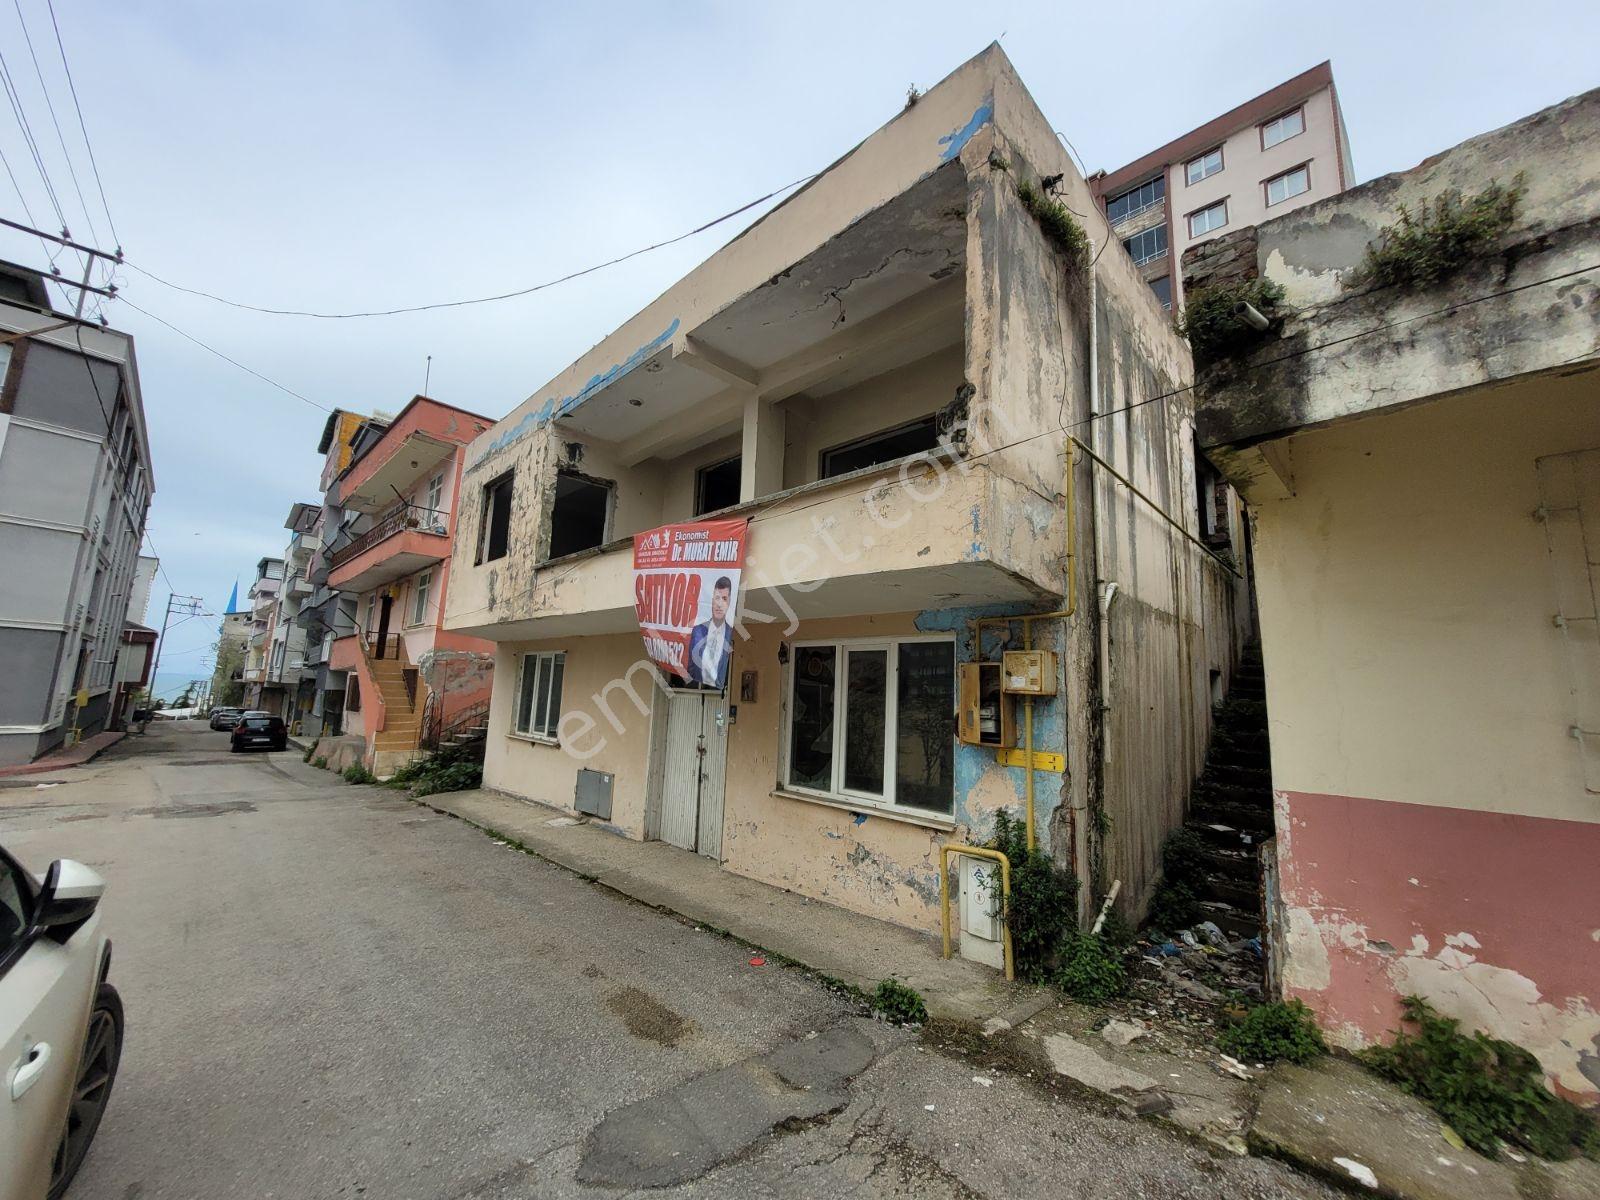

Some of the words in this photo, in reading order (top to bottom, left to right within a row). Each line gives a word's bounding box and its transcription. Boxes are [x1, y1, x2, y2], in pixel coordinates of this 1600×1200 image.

[674, 530, 710, 541] Ekonomist
[671, 543, 682, 562] Dr.
[683, 541, 714, 562] MURAT
[636, 573, 702, 628] SATIYOR
